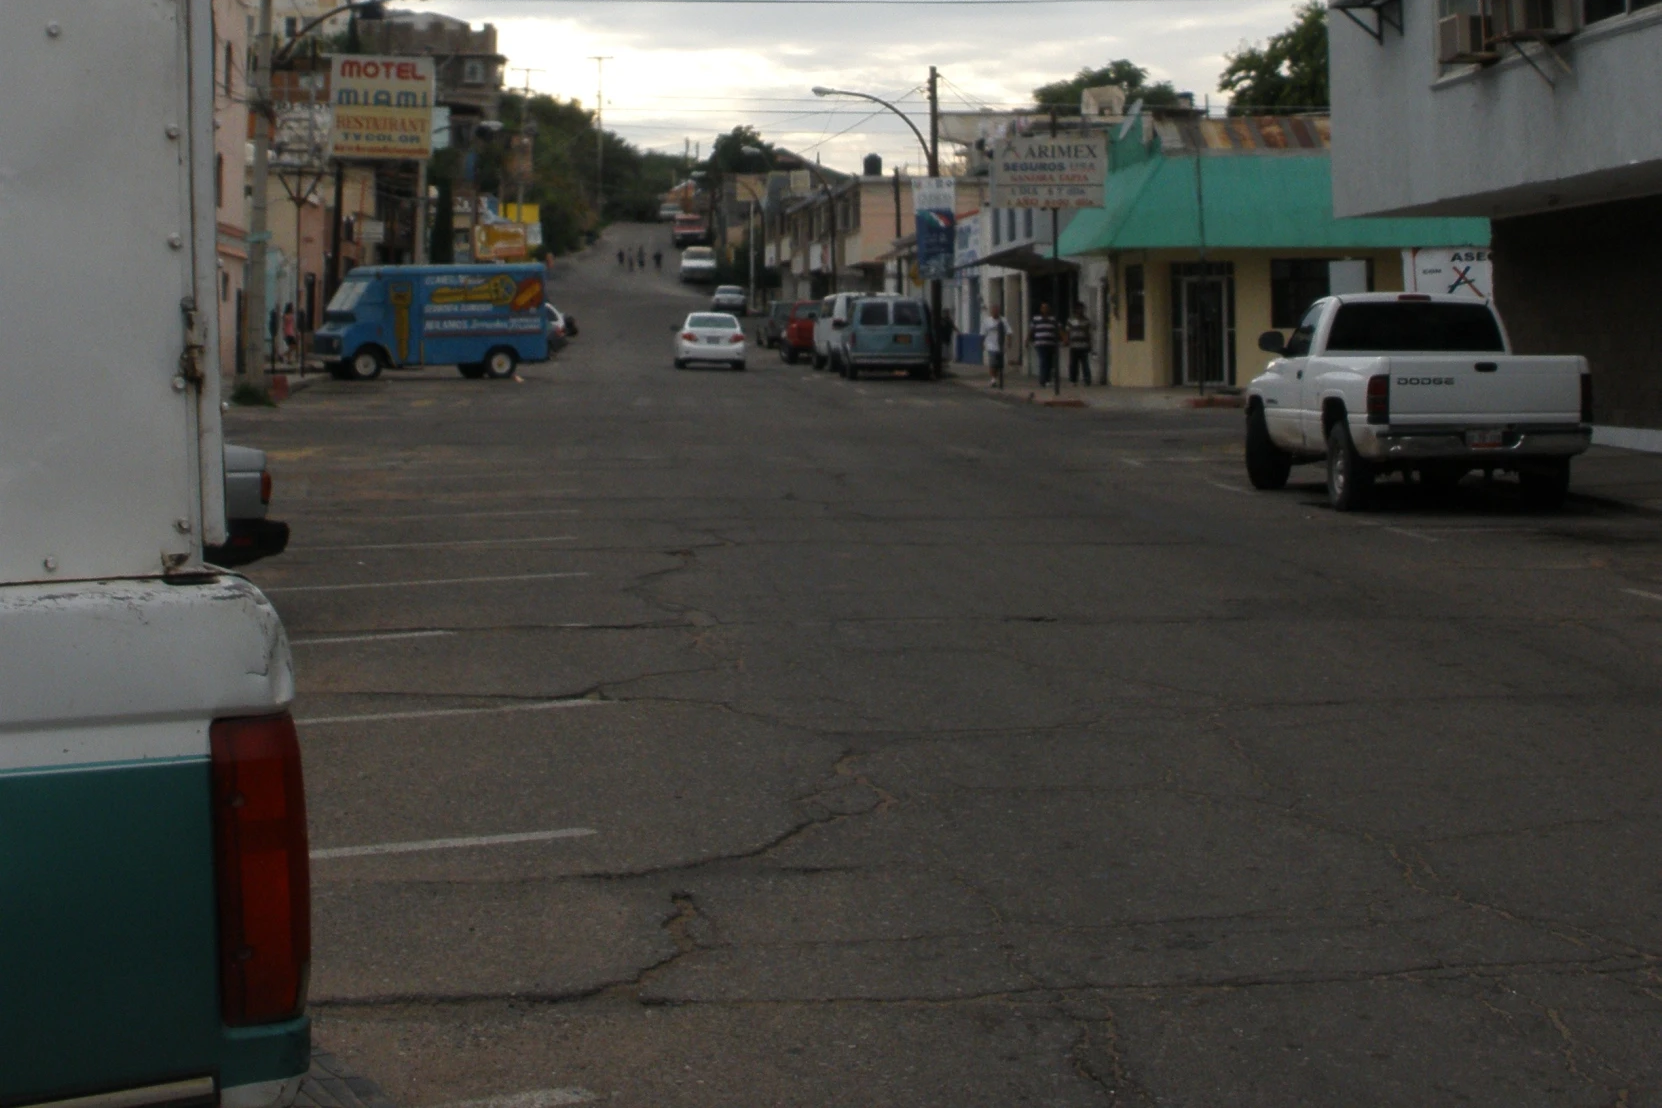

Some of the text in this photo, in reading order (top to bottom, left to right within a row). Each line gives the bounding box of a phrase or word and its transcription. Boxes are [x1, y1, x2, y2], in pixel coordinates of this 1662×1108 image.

[340, 59, 426, 81] MOTEL
[337, 88, 428, 109] MIAMI
[1025, 144, 1097, 159] ARIMEX
[1003, 162, 1066, 172] SEGUROS
[1397, 377, 1455, 386] DODGE
